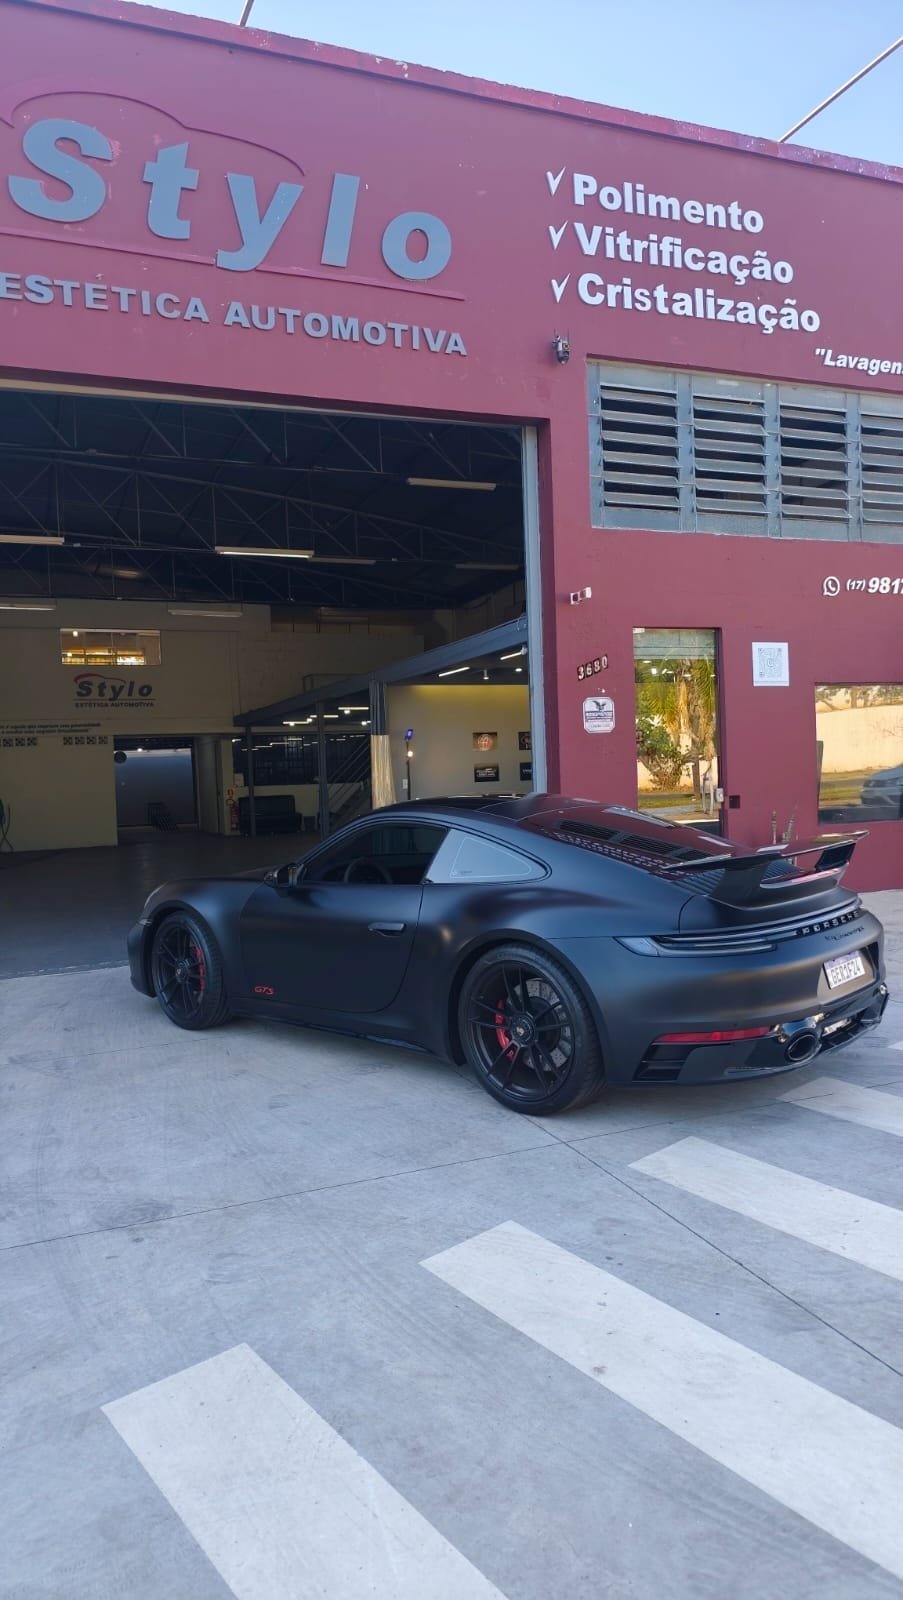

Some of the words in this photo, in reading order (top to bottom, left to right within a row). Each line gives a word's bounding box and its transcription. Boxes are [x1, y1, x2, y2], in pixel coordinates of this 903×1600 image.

[8, 118, 452, 281] Stylo
[572, 173, 764, 233] Polimento
[573, 222, 794, 285] Vitrificação
[577, 272, 821, 334] Cristalização
[224, 301, 467, 356] AUTOMOTIVA
[815, 348, 903, 376] "Lavagen
[846, 578, 866, 592] (17)
[577, 655, 609, 680] 3680
[76, 680, 153, 702] Stylo
[254, 985, 274, 995] GTS
